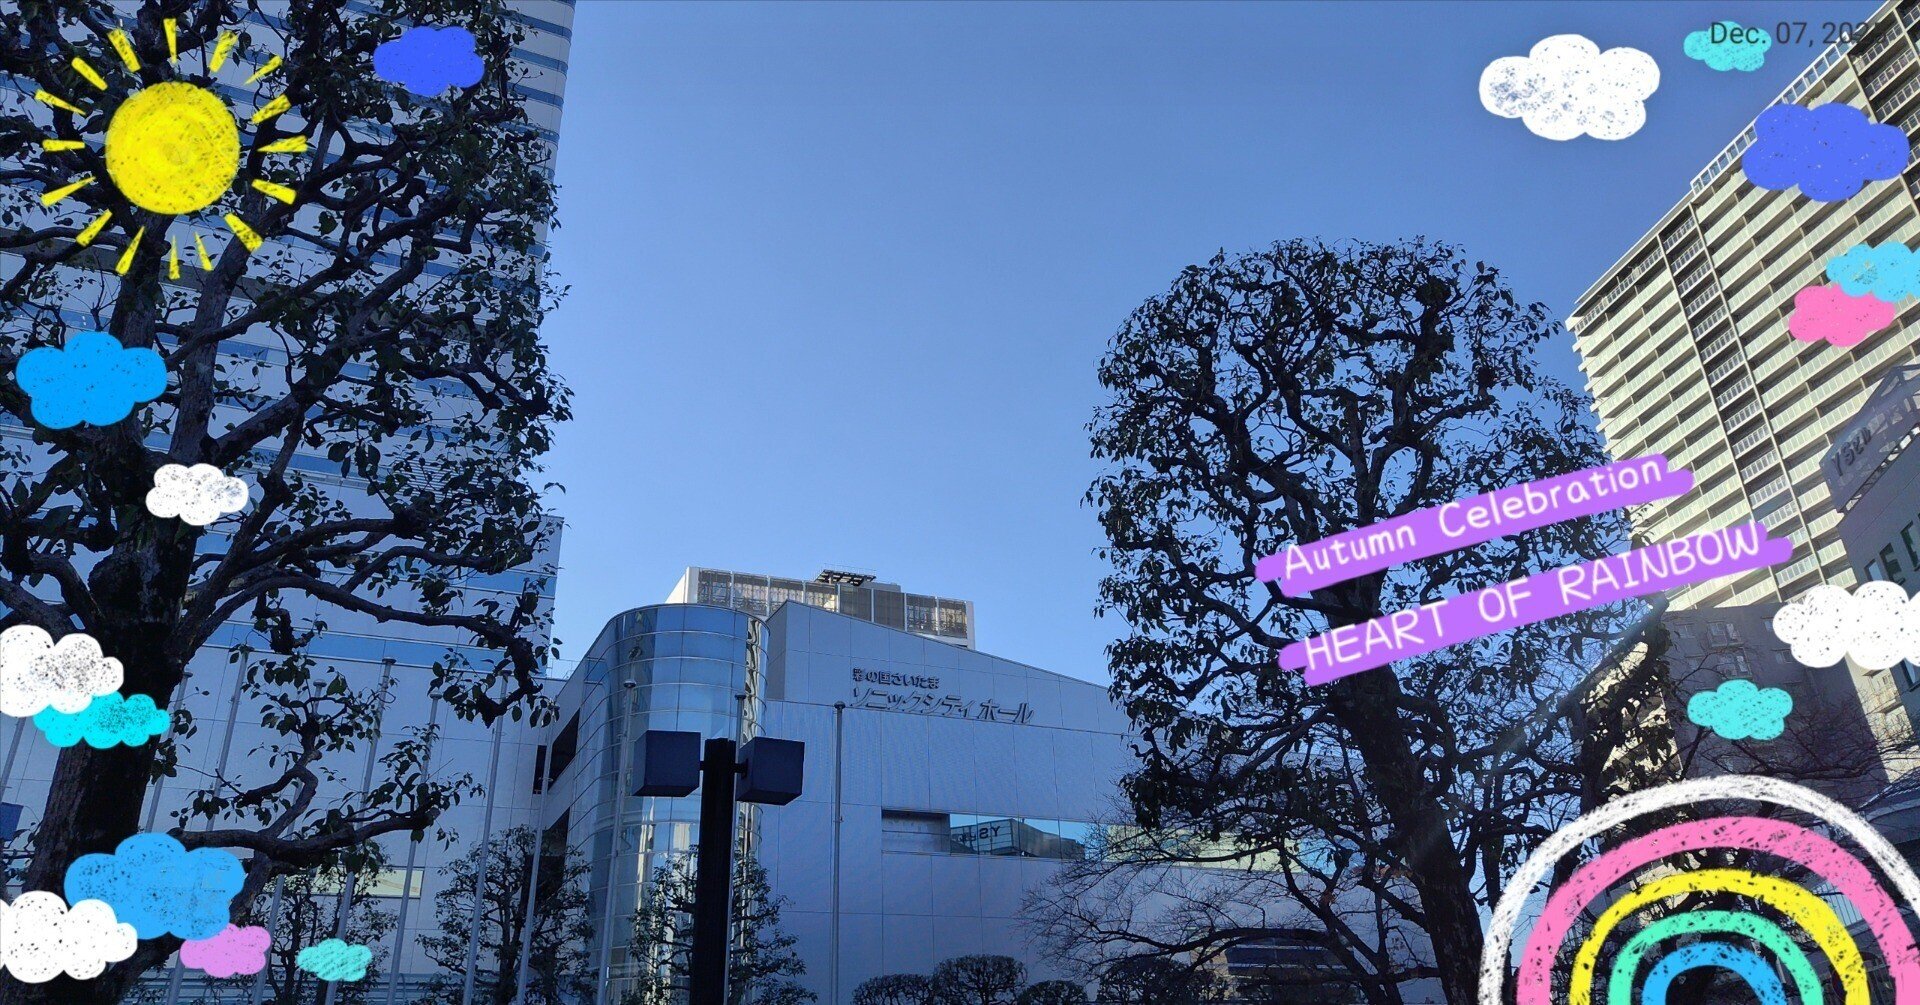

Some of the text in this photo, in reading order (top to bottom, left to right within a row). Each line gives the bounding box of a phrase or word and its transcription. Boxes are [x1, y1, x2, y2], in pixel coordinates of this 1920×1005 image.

[852, 667, 940, 690] 彩の国さいたま
